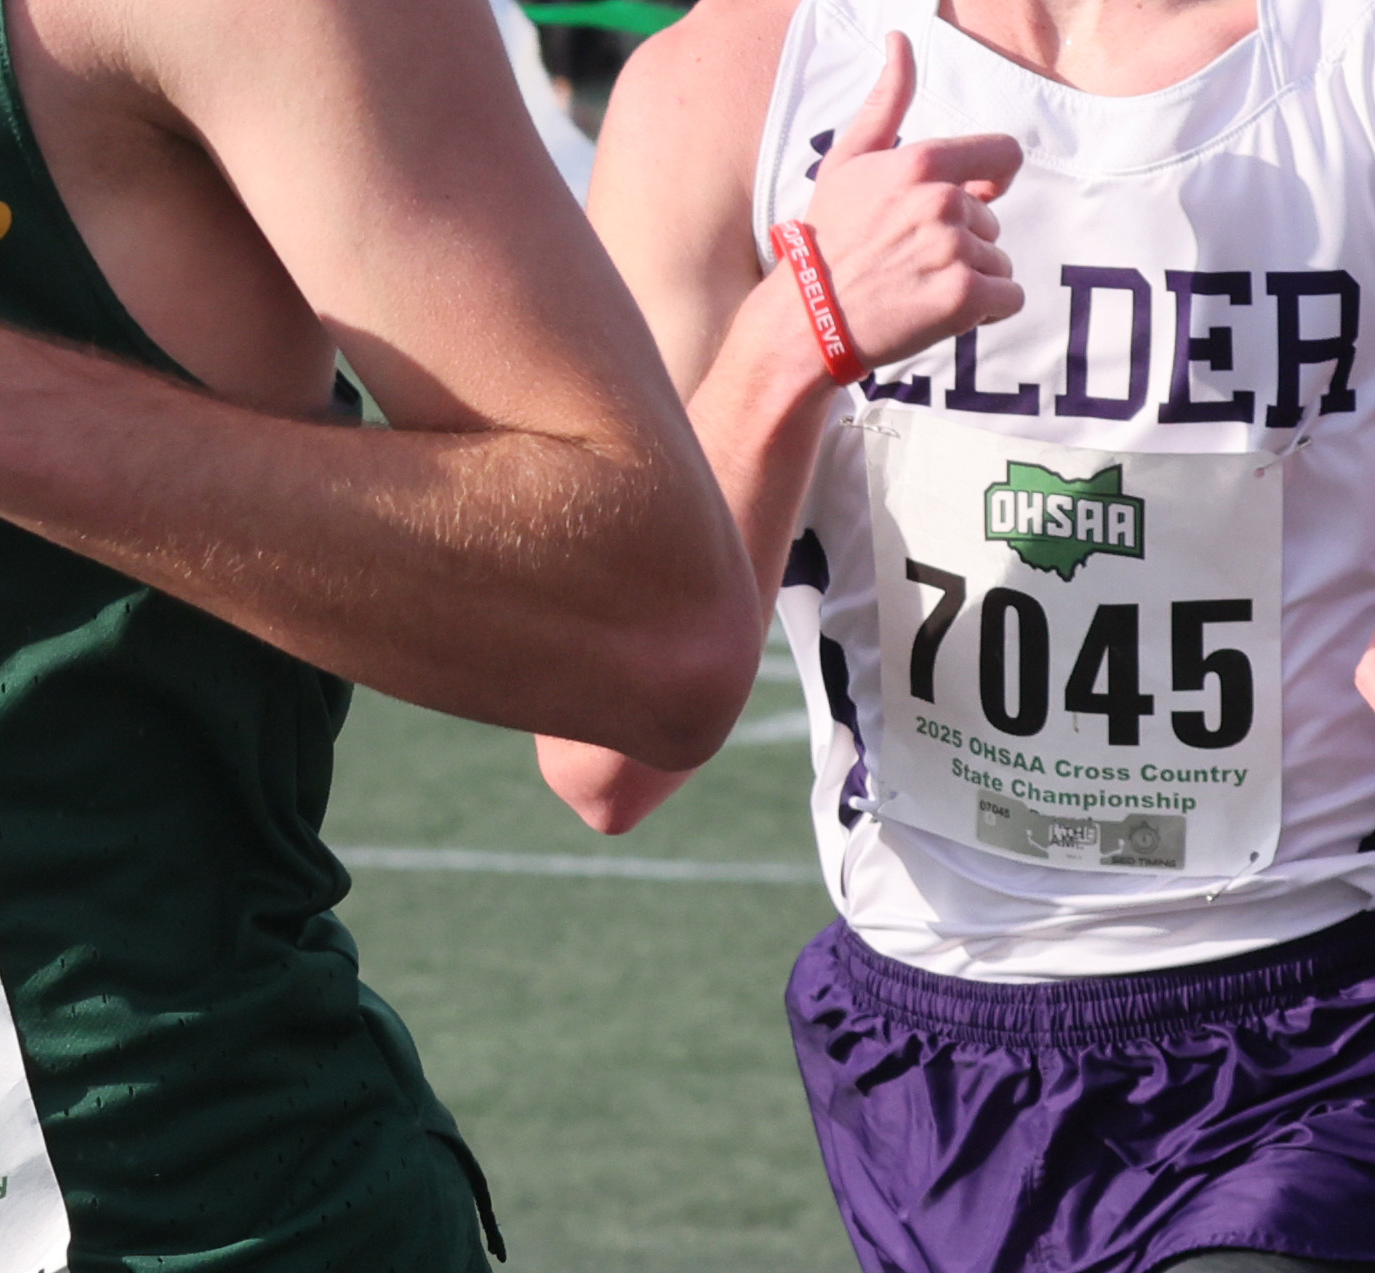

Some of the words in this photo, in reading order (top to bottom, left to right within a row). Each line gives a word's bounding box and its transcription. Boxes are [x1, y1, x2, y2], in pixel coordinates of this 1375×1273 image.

[858, 264, 1361, 428] LDER
[990, 490, 1136, 548] OHSAA
[904, 558, 1255, 749] 7045
[915, 716, 963, 749] 2025
[968, 737, 1046, 775] OHSAA
[1055, 759, 1131, 780] Cross
[1140, 763, 1248, 787] Country
[951, 757, 1004, 792] State
[1011, 778, 1197, 814] Championship
[978, 799, 1012, 820] 07045
